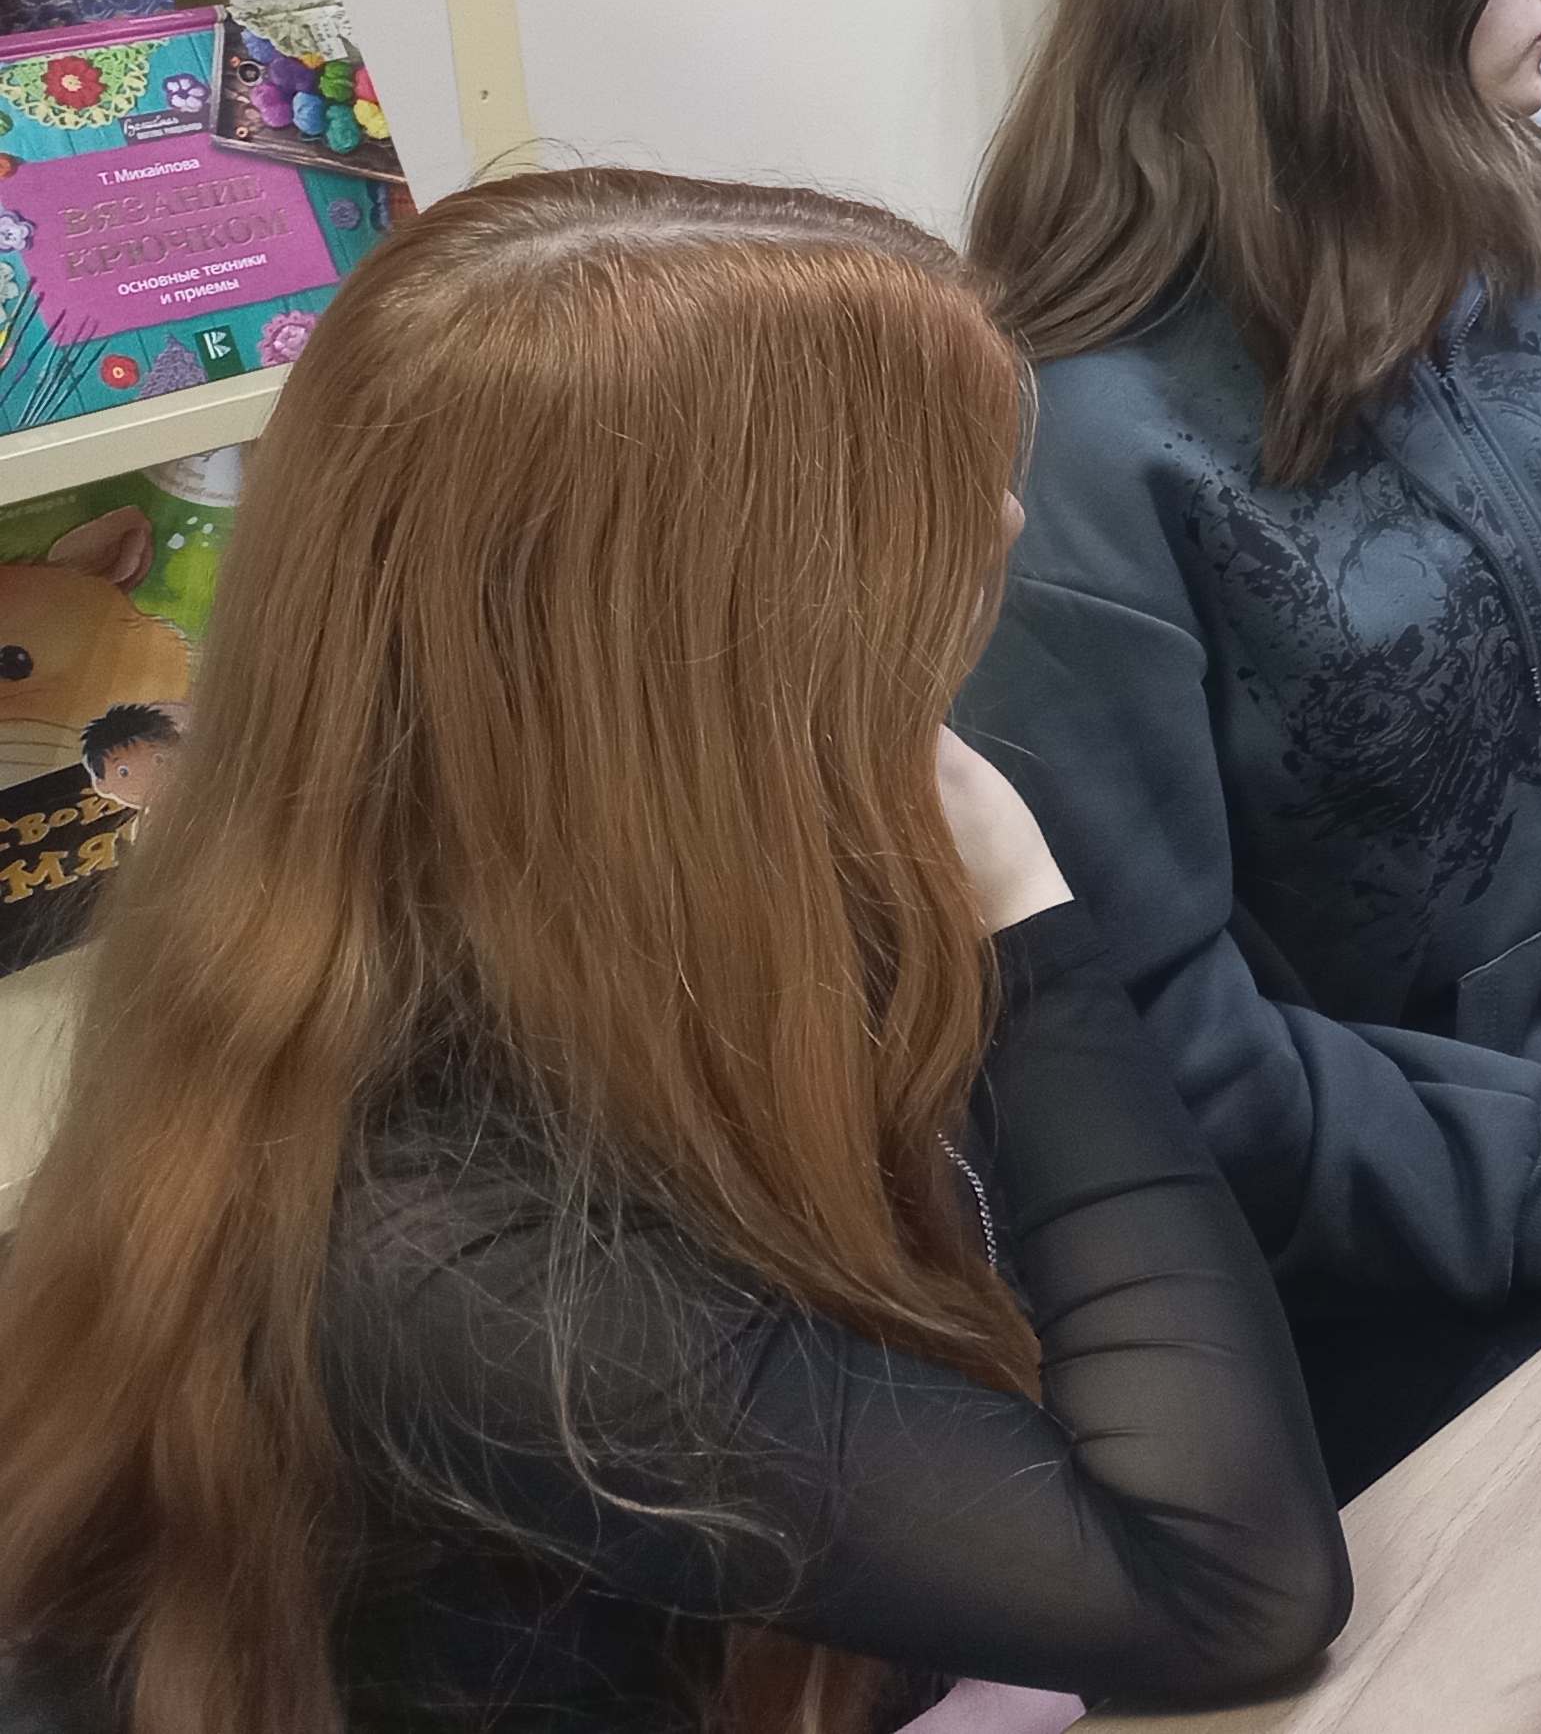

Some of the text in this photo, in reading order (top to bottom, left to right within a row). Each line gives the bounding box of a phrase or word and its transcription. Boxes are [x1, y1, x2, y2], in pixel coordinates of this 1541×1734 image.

[114, 158, 201, 185] Михайлова
[58, 173, 266, 240] ВЯЗАНИЕ
[60, 207, 294, 282] КРЮЧКОМ
[117, 253, 268, 296] основные техники
[160, 278, 241, 306] и приемы
